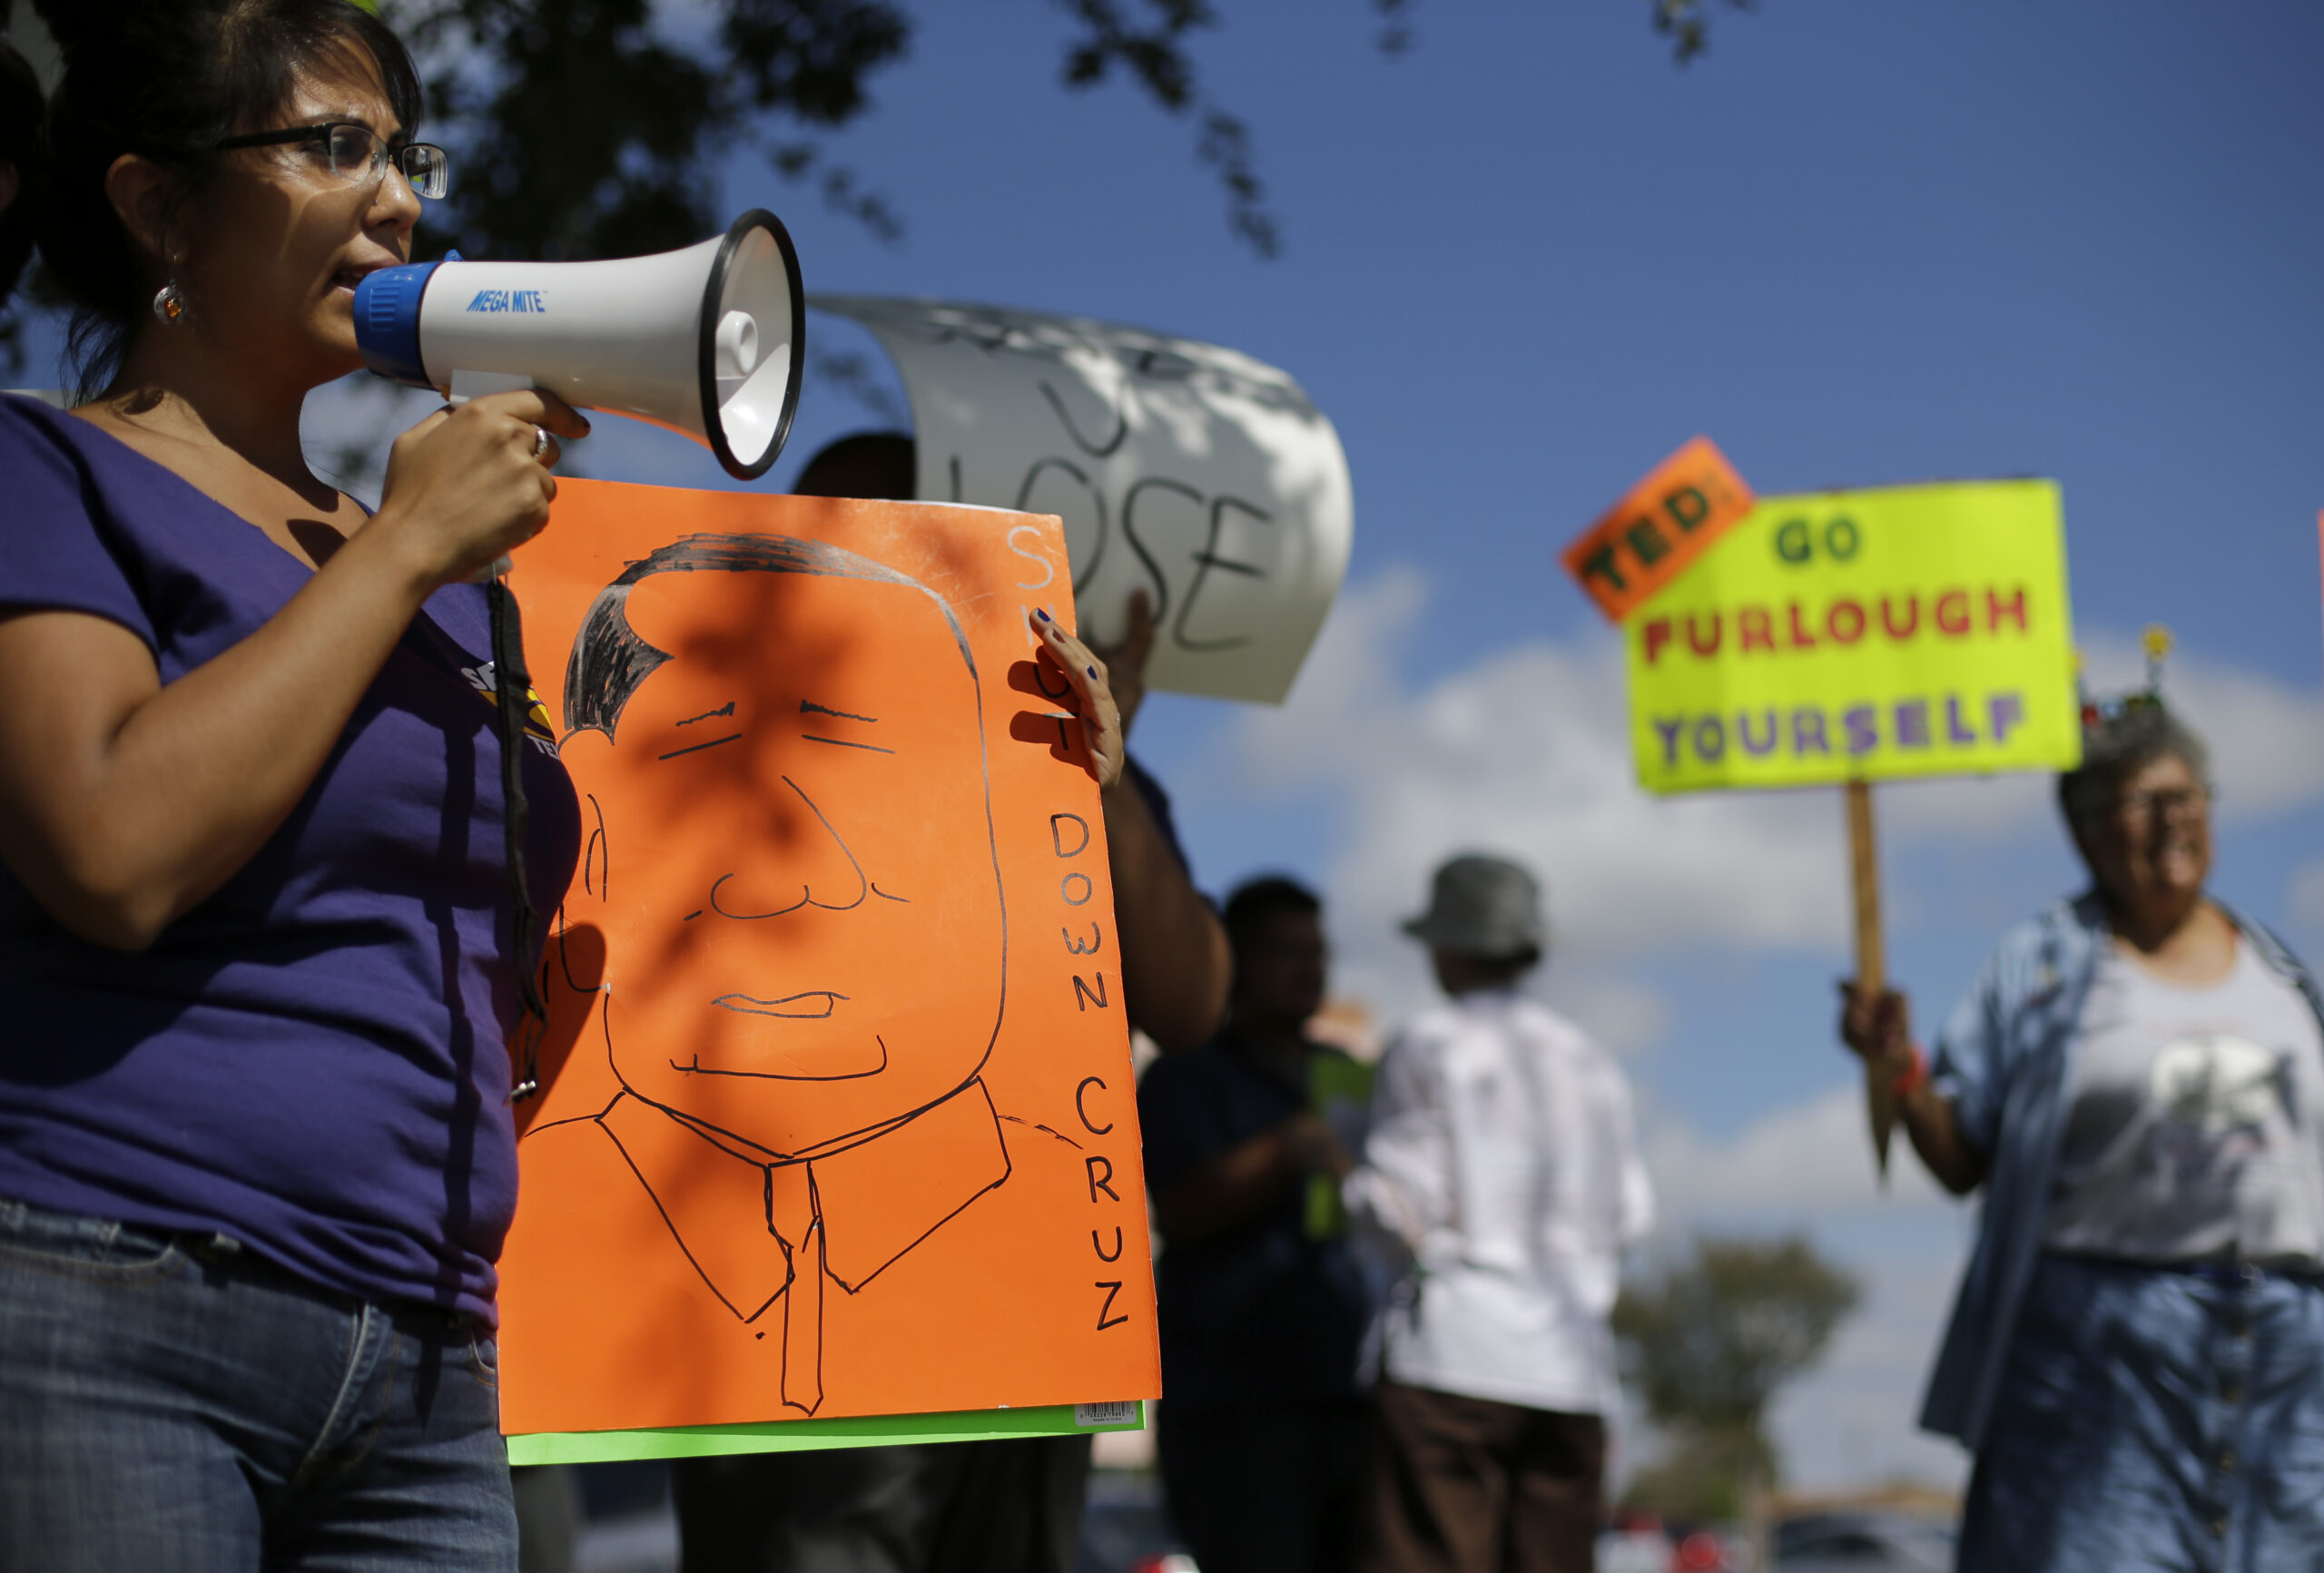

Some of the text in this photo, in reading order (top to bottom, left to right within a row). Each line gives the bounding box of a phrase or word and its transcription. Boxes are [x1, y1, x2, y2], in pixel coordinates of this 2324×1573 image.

[466, 290, 509, 312] MEGA
[1775, 516, 1861, 568] GO
[1643, 586, 2030, 667] FURLOUGH
[1651, 693, 2024, 768] YOURSELF
[1050, 812, 1108, 1011] DOWN
[1076, 1077, 1129, 1331] CRUZ
